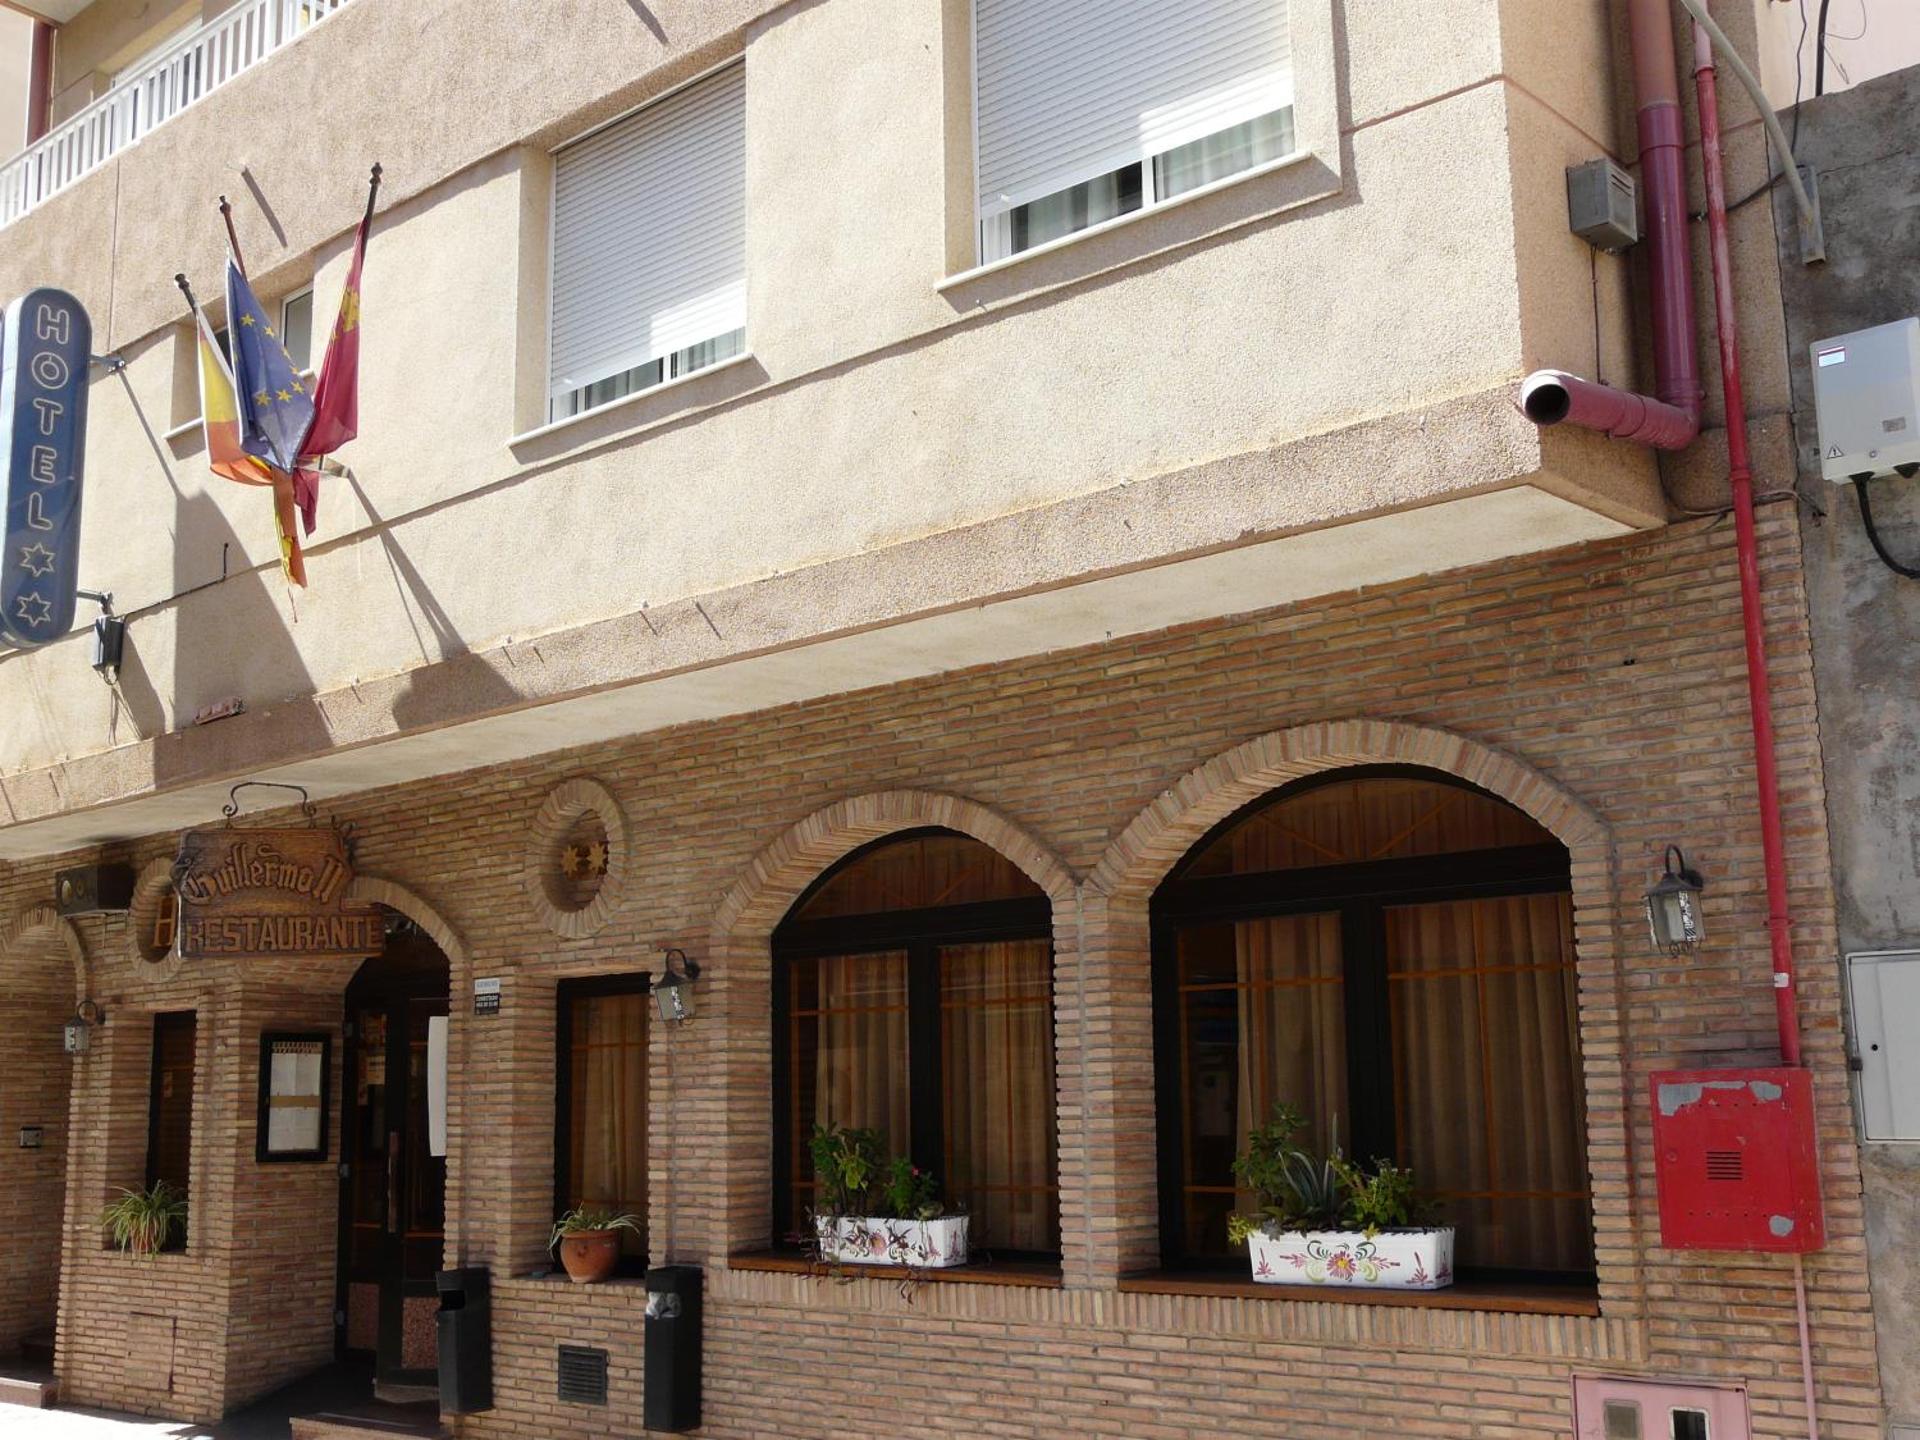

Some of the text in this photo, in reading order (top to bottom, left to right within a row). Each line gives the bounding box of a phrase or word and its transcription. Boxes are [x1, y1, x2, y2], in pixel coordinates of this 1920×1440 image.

[28, 304, 70, 531] HOTEL
[177, 842, 314, 905] Guillermo
[186, 915, 383, 951] RESTAURANTE
